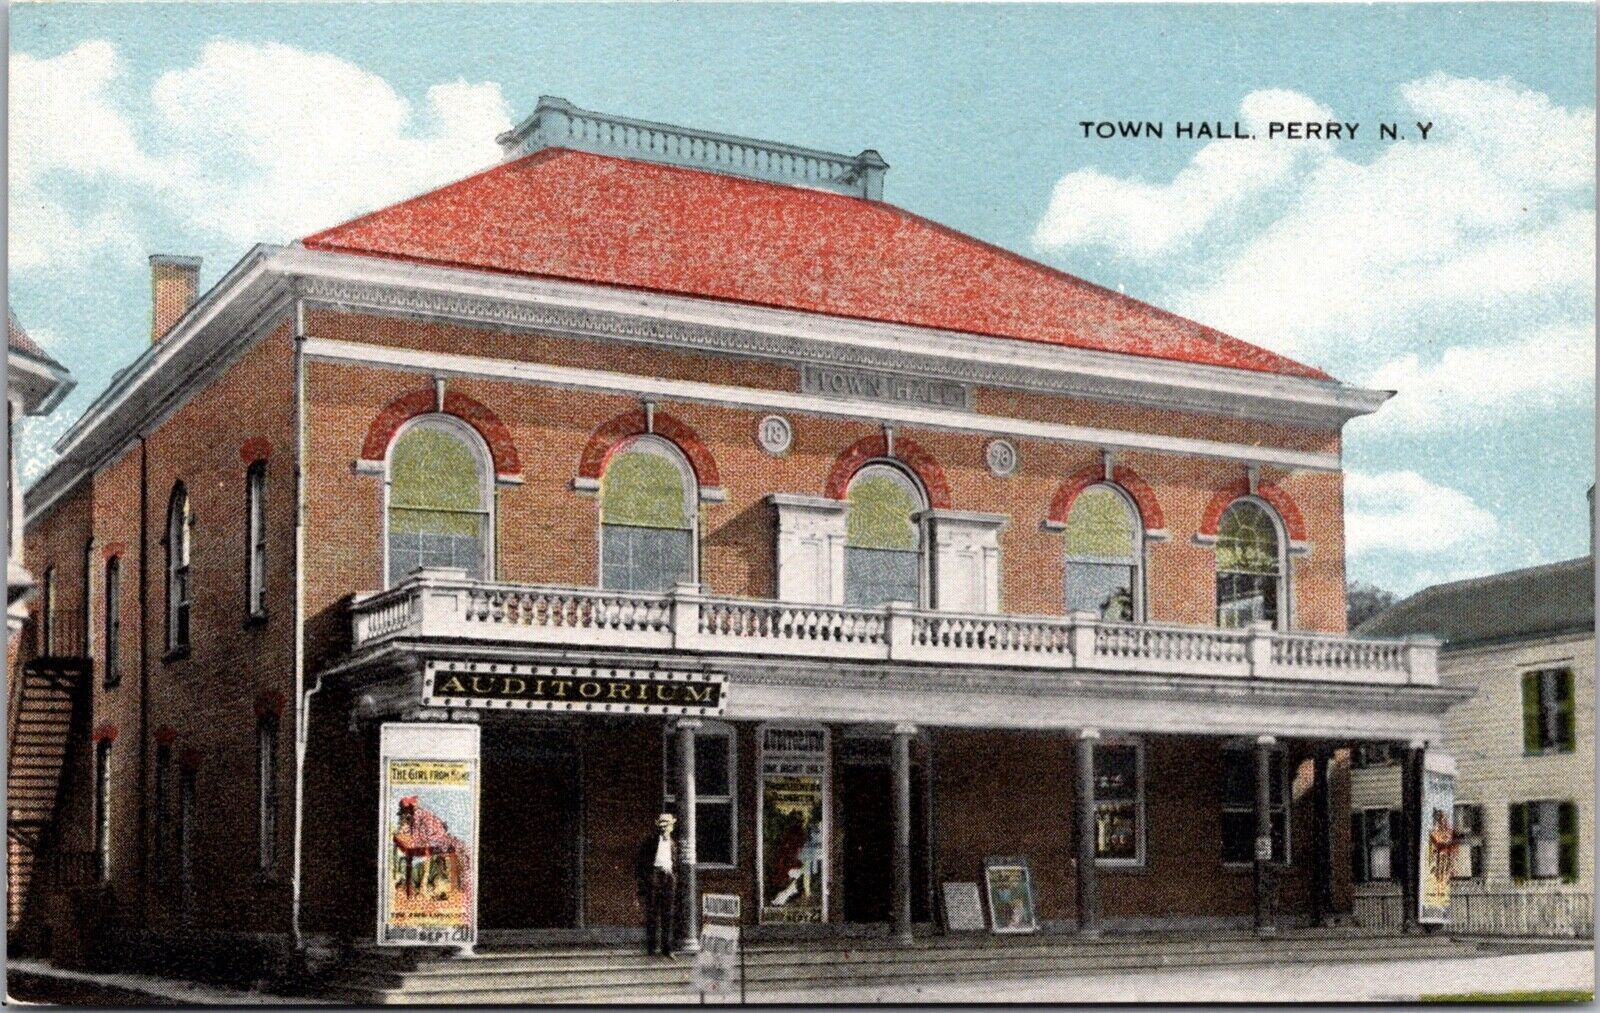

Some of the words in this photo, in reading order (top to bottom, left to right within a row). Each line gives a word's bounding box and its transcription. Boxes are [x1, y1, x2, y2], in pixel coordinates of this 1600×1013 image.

[818, 371, 880, 397] TOWN
[894, 377, 954, 405] HALL
[440, 675, 713, 702] AUDITORIUM
[391, 767, 407, 780] THE
